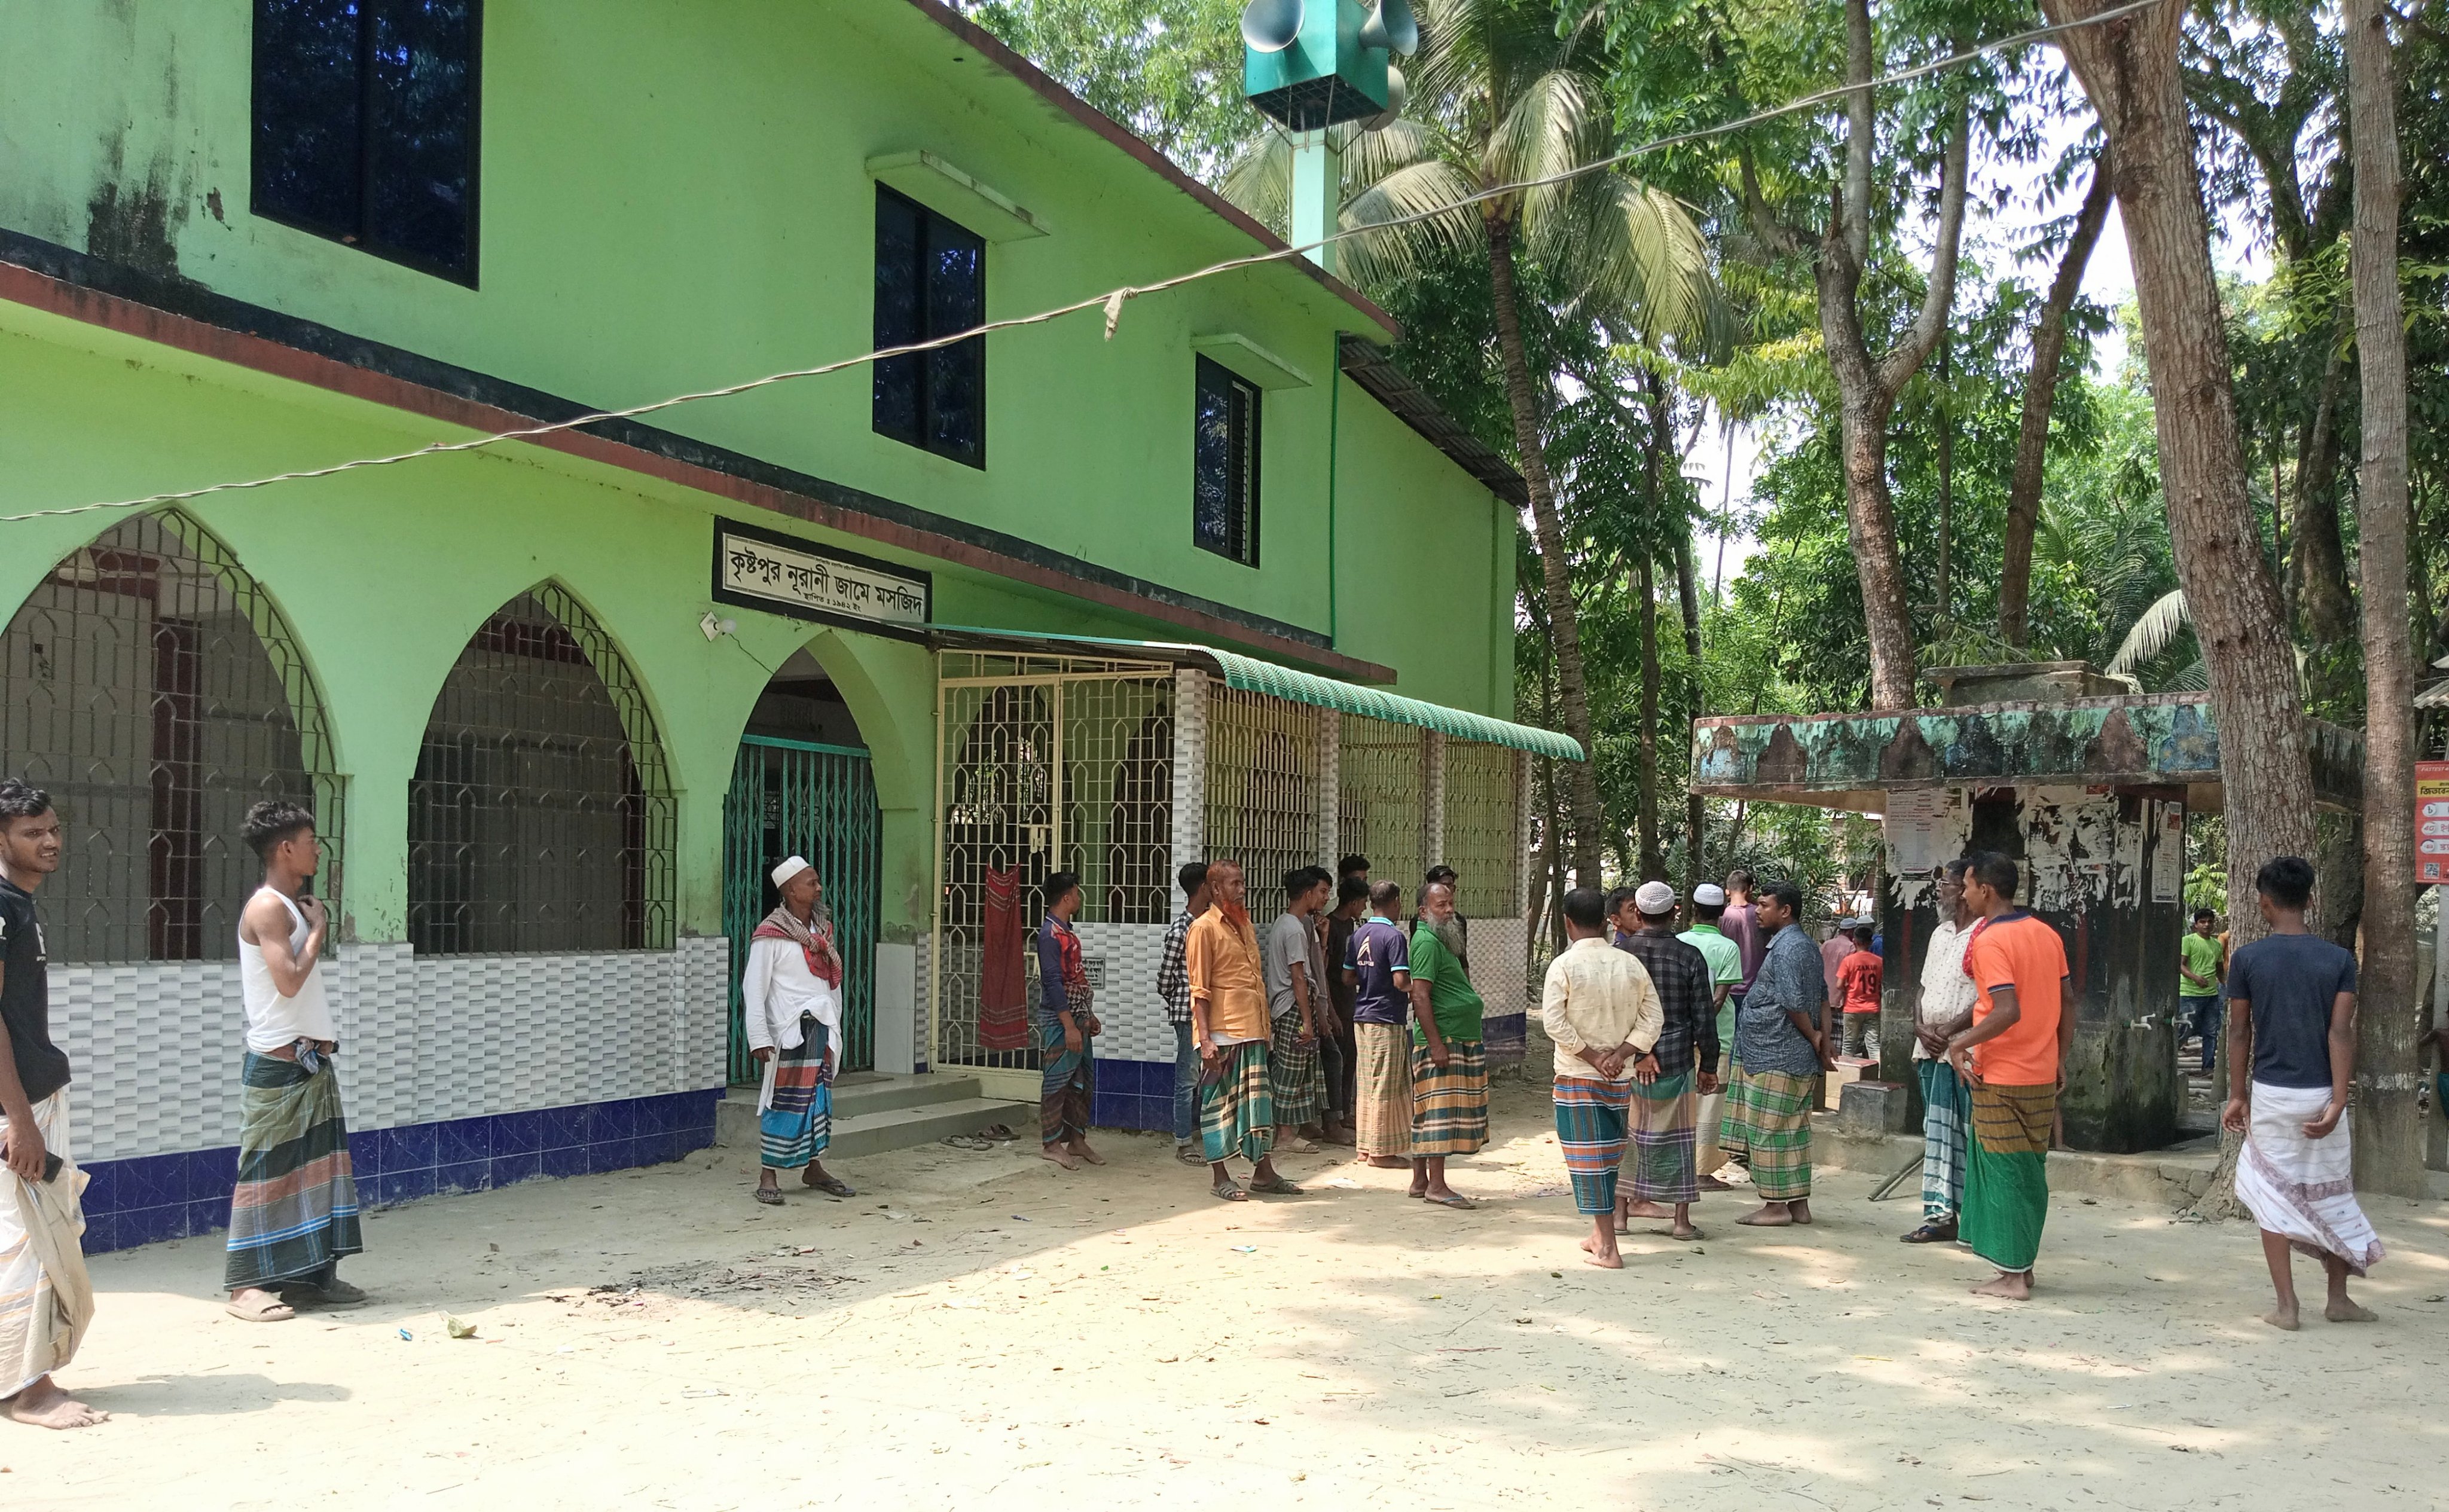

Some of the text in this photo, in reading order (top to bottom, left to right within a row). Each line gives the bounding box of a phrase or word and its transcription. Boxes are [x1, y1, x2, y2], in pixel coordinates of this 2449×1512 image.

[729, 546, 781, 587] কৃষ্টপুর
[786, 564, 830, 595] নূরানী
[833, 576, 871, 604] জামে
[875, 585, 923, 616] মসজিদ
[1859, 973, 1877, 994] 19
